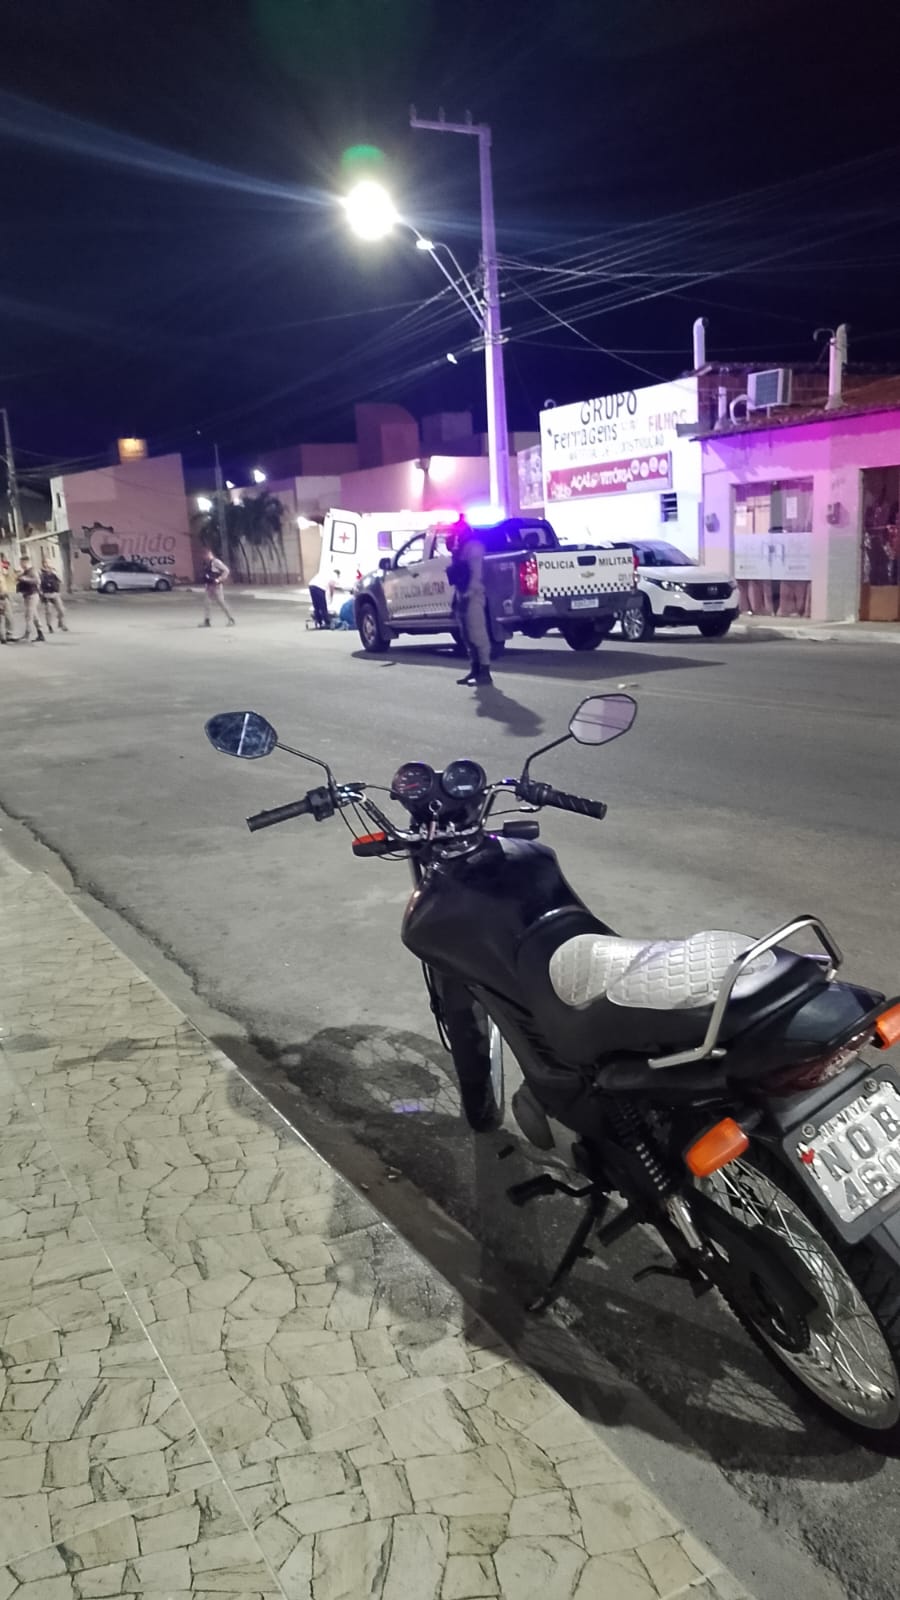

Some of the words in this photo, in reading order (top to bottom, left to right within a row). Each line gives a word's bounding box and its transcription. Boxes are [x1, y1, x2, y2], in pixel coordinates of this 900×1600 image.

[579, 390, 638, 425] GRUPO
[538, 560, 575, 570] POLICIA
[598, 556, 633, 567] MILITAR
[817, 1104, 900, 1181] NOB
[843, 1135, 900, 1211] 460
